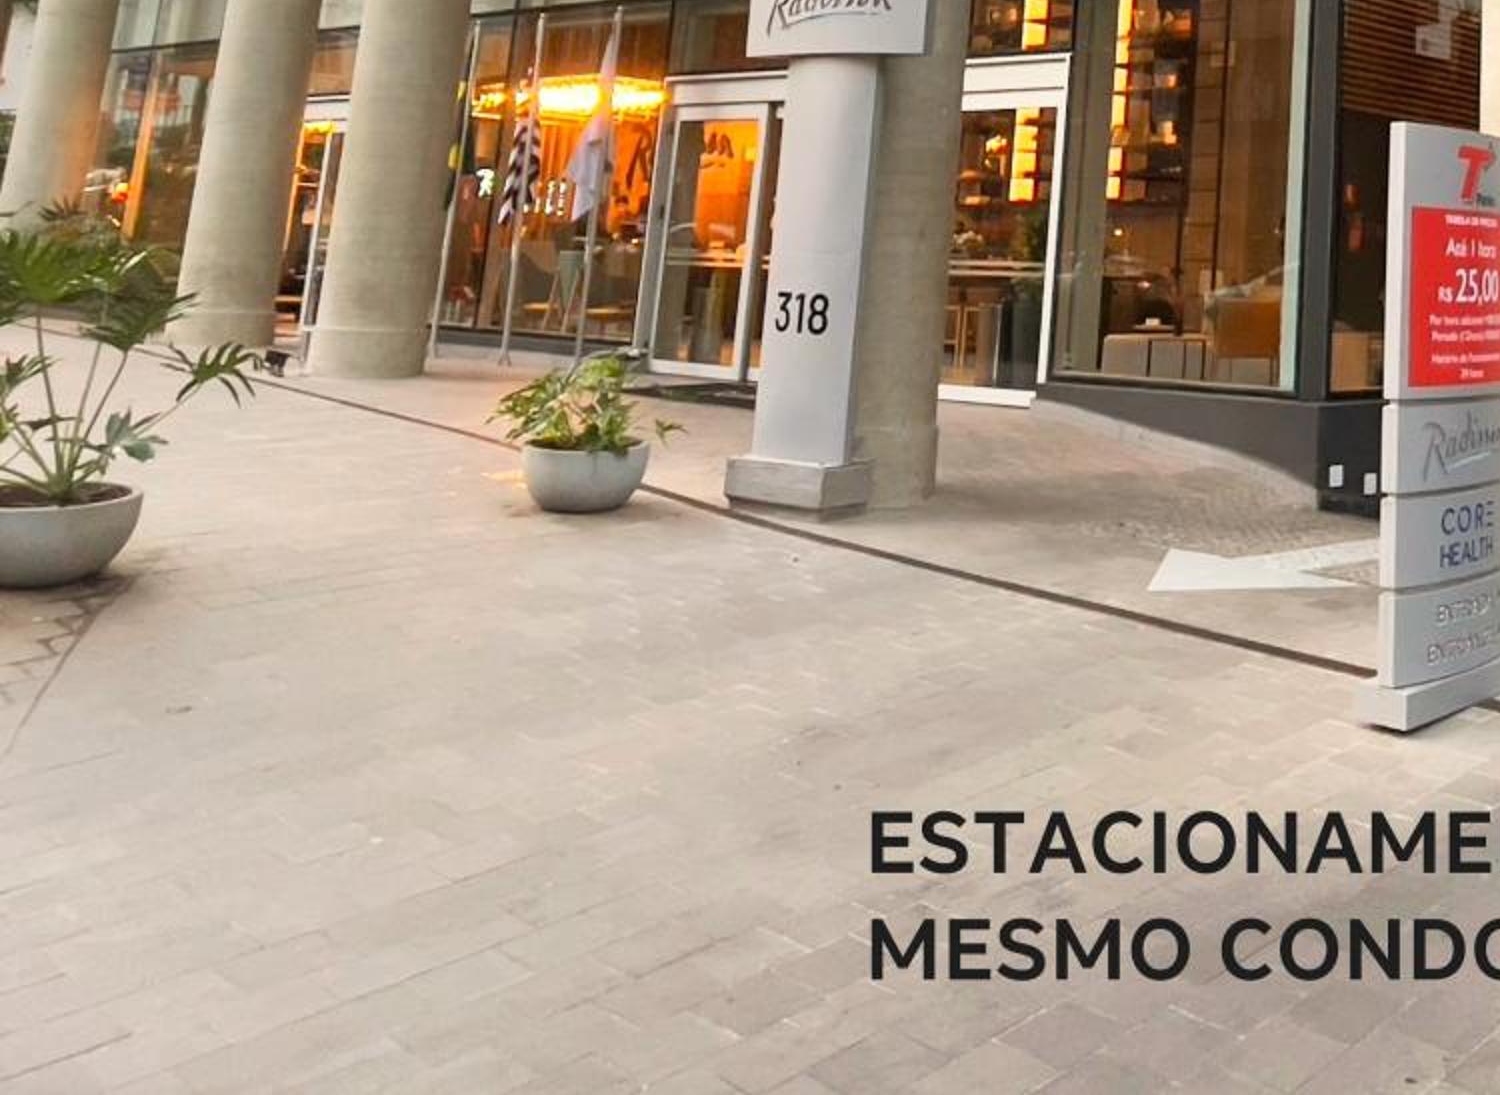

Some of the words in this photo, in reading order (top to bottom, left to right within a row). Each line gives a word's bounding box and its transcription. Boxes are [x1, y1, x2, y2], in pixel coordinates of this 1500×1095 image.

[1455, 268, 1500, 307] 25,00
[774, 291, 830, 336] 318
[1440, 500, 1495, 537] CORE
[1440, 535, 1494, 570] HEALTH
